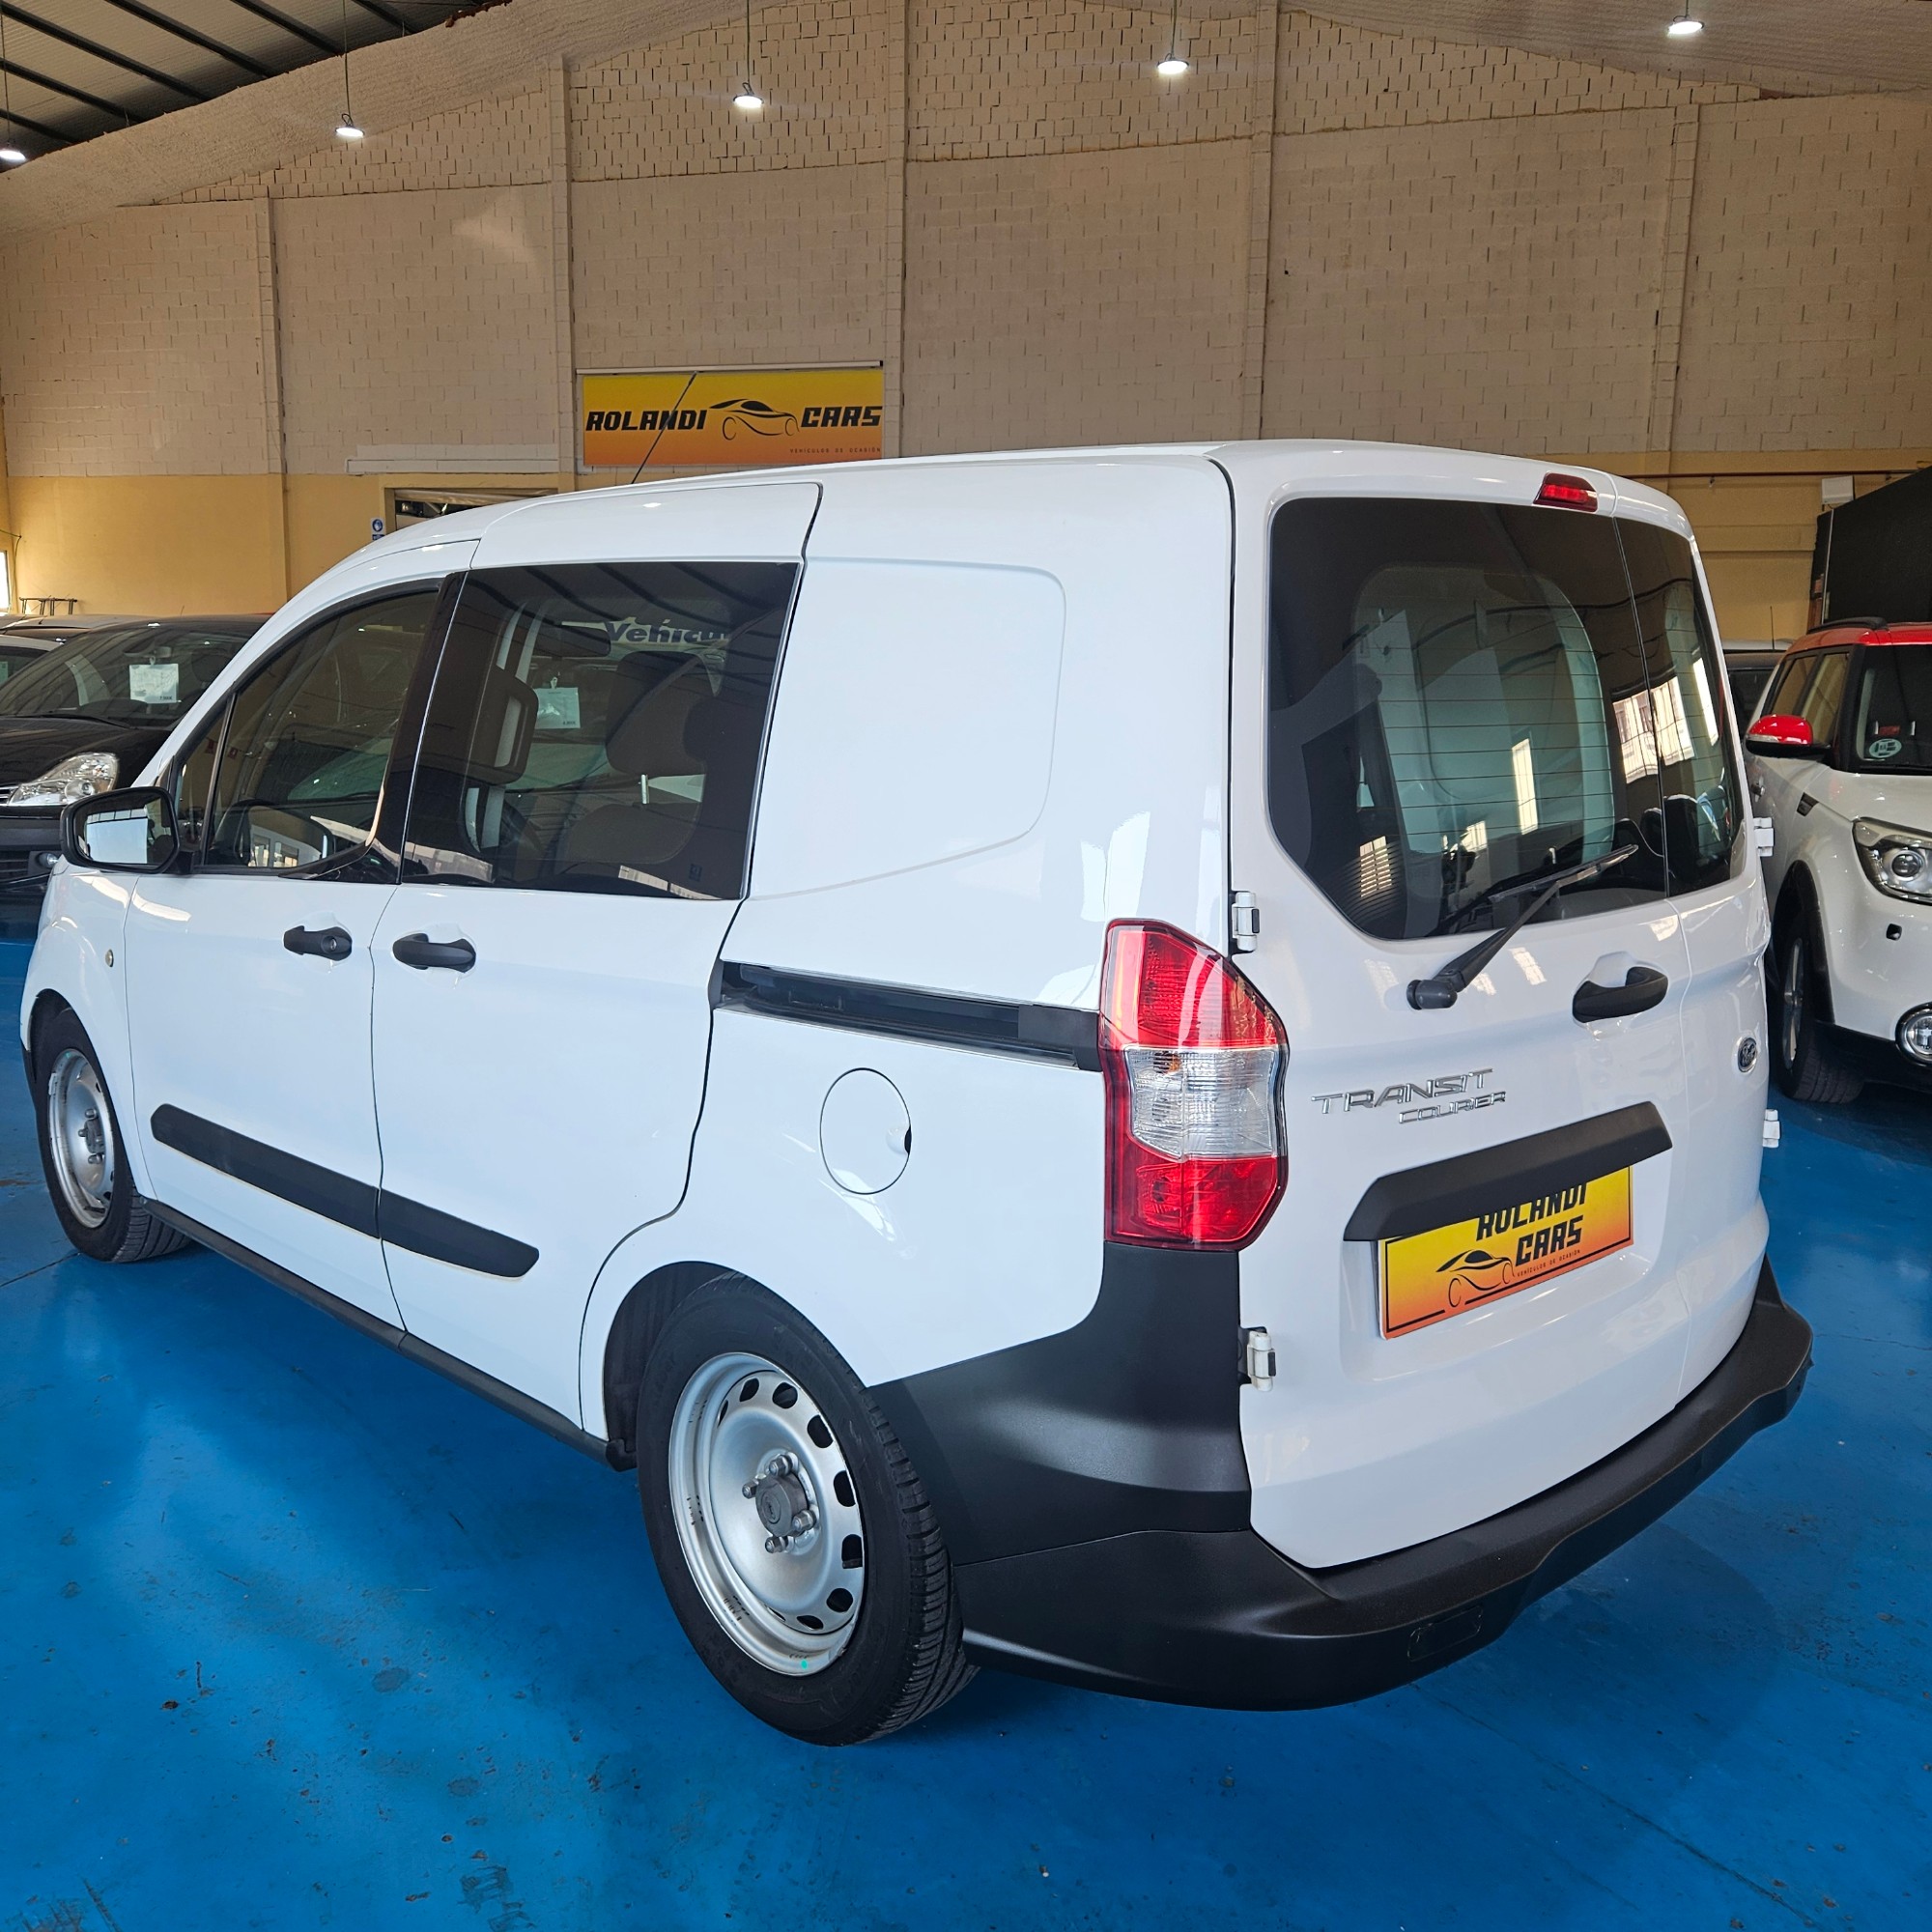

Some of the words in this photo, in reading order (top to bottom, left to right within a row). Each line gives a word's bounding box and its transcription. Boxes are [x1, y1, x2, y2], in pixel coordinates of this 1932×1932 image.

[585, 410, 707, 431] ROLANDI
[801, 406, 883, 427] CARS
[1311, 1068, 1493, 1114] TRANSIT
[1399, 1091, 1506, 1123] COURIER
[1476, 1182, 1587, 1241] ROLANDI
[1516, 1214, 1583, 1266] CARS
